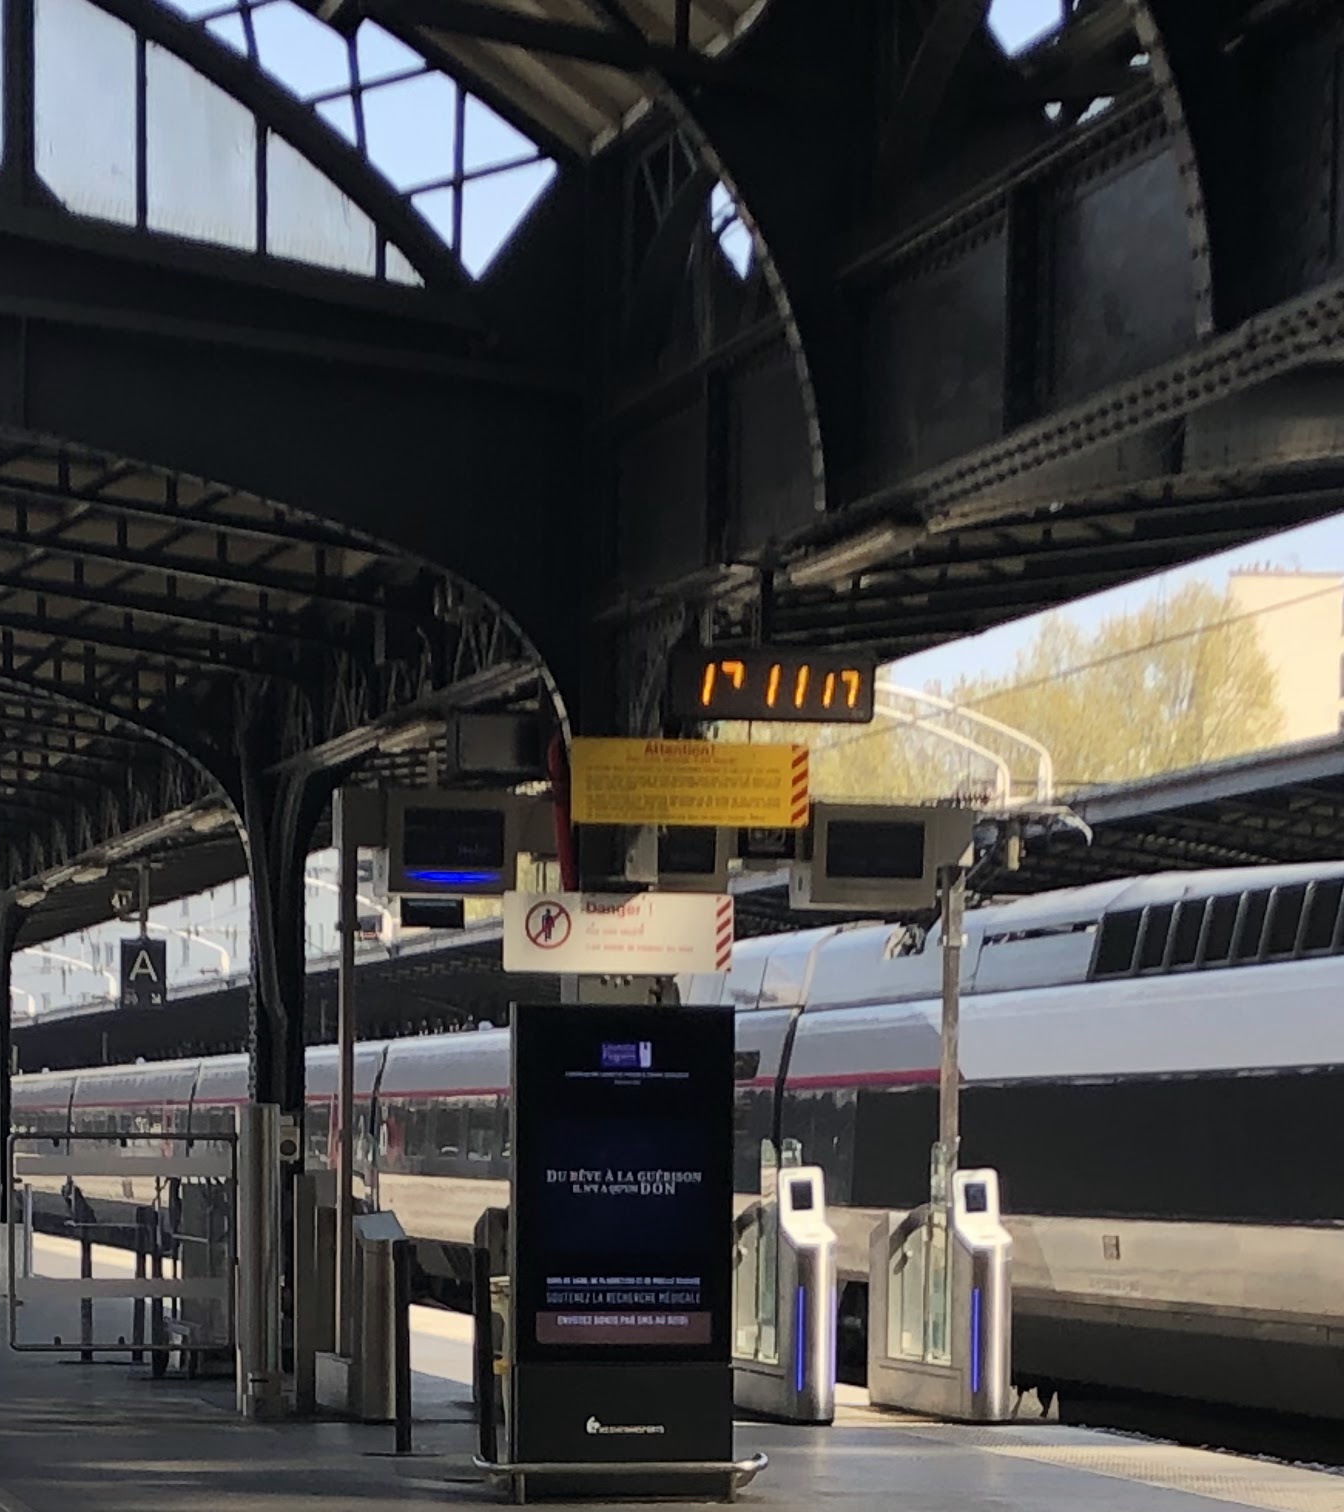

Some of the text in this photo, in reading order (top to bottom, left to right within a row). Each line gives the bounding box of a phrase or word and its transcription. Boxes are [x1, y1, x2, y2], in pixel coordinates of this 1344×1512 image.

[586, 900, 641, 918] Danger
[129, 949, 158, 982] A
[640, 1182, 676, 1195] DON
